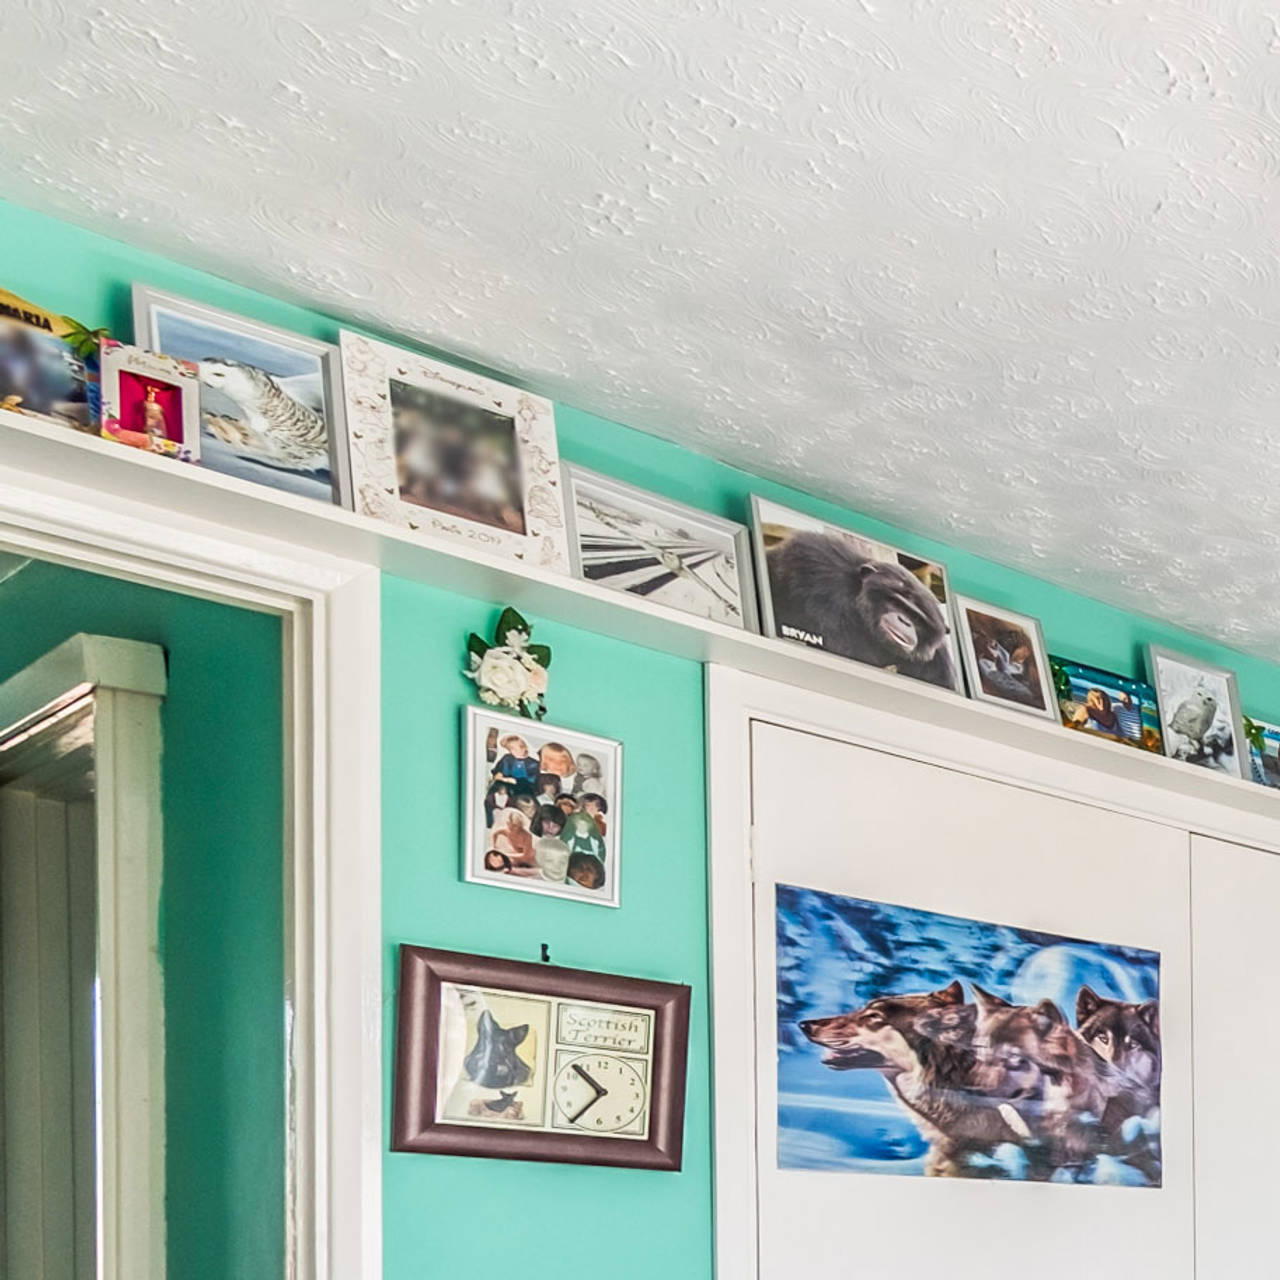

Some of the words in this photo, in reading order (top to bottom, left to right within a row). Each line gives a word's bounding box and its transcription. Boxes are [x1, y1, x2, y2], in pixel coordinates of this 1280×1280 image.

[781, 624, 824, 646] BRYAN
[566, 1012, 639, 1033] Scottish
[568, 1029, 637, 1047] Terrier
[598, 1061, 609, 1070] 12
[618, 1067, 623, 1075] 1
[630, 1078, 635, 1086] 2
